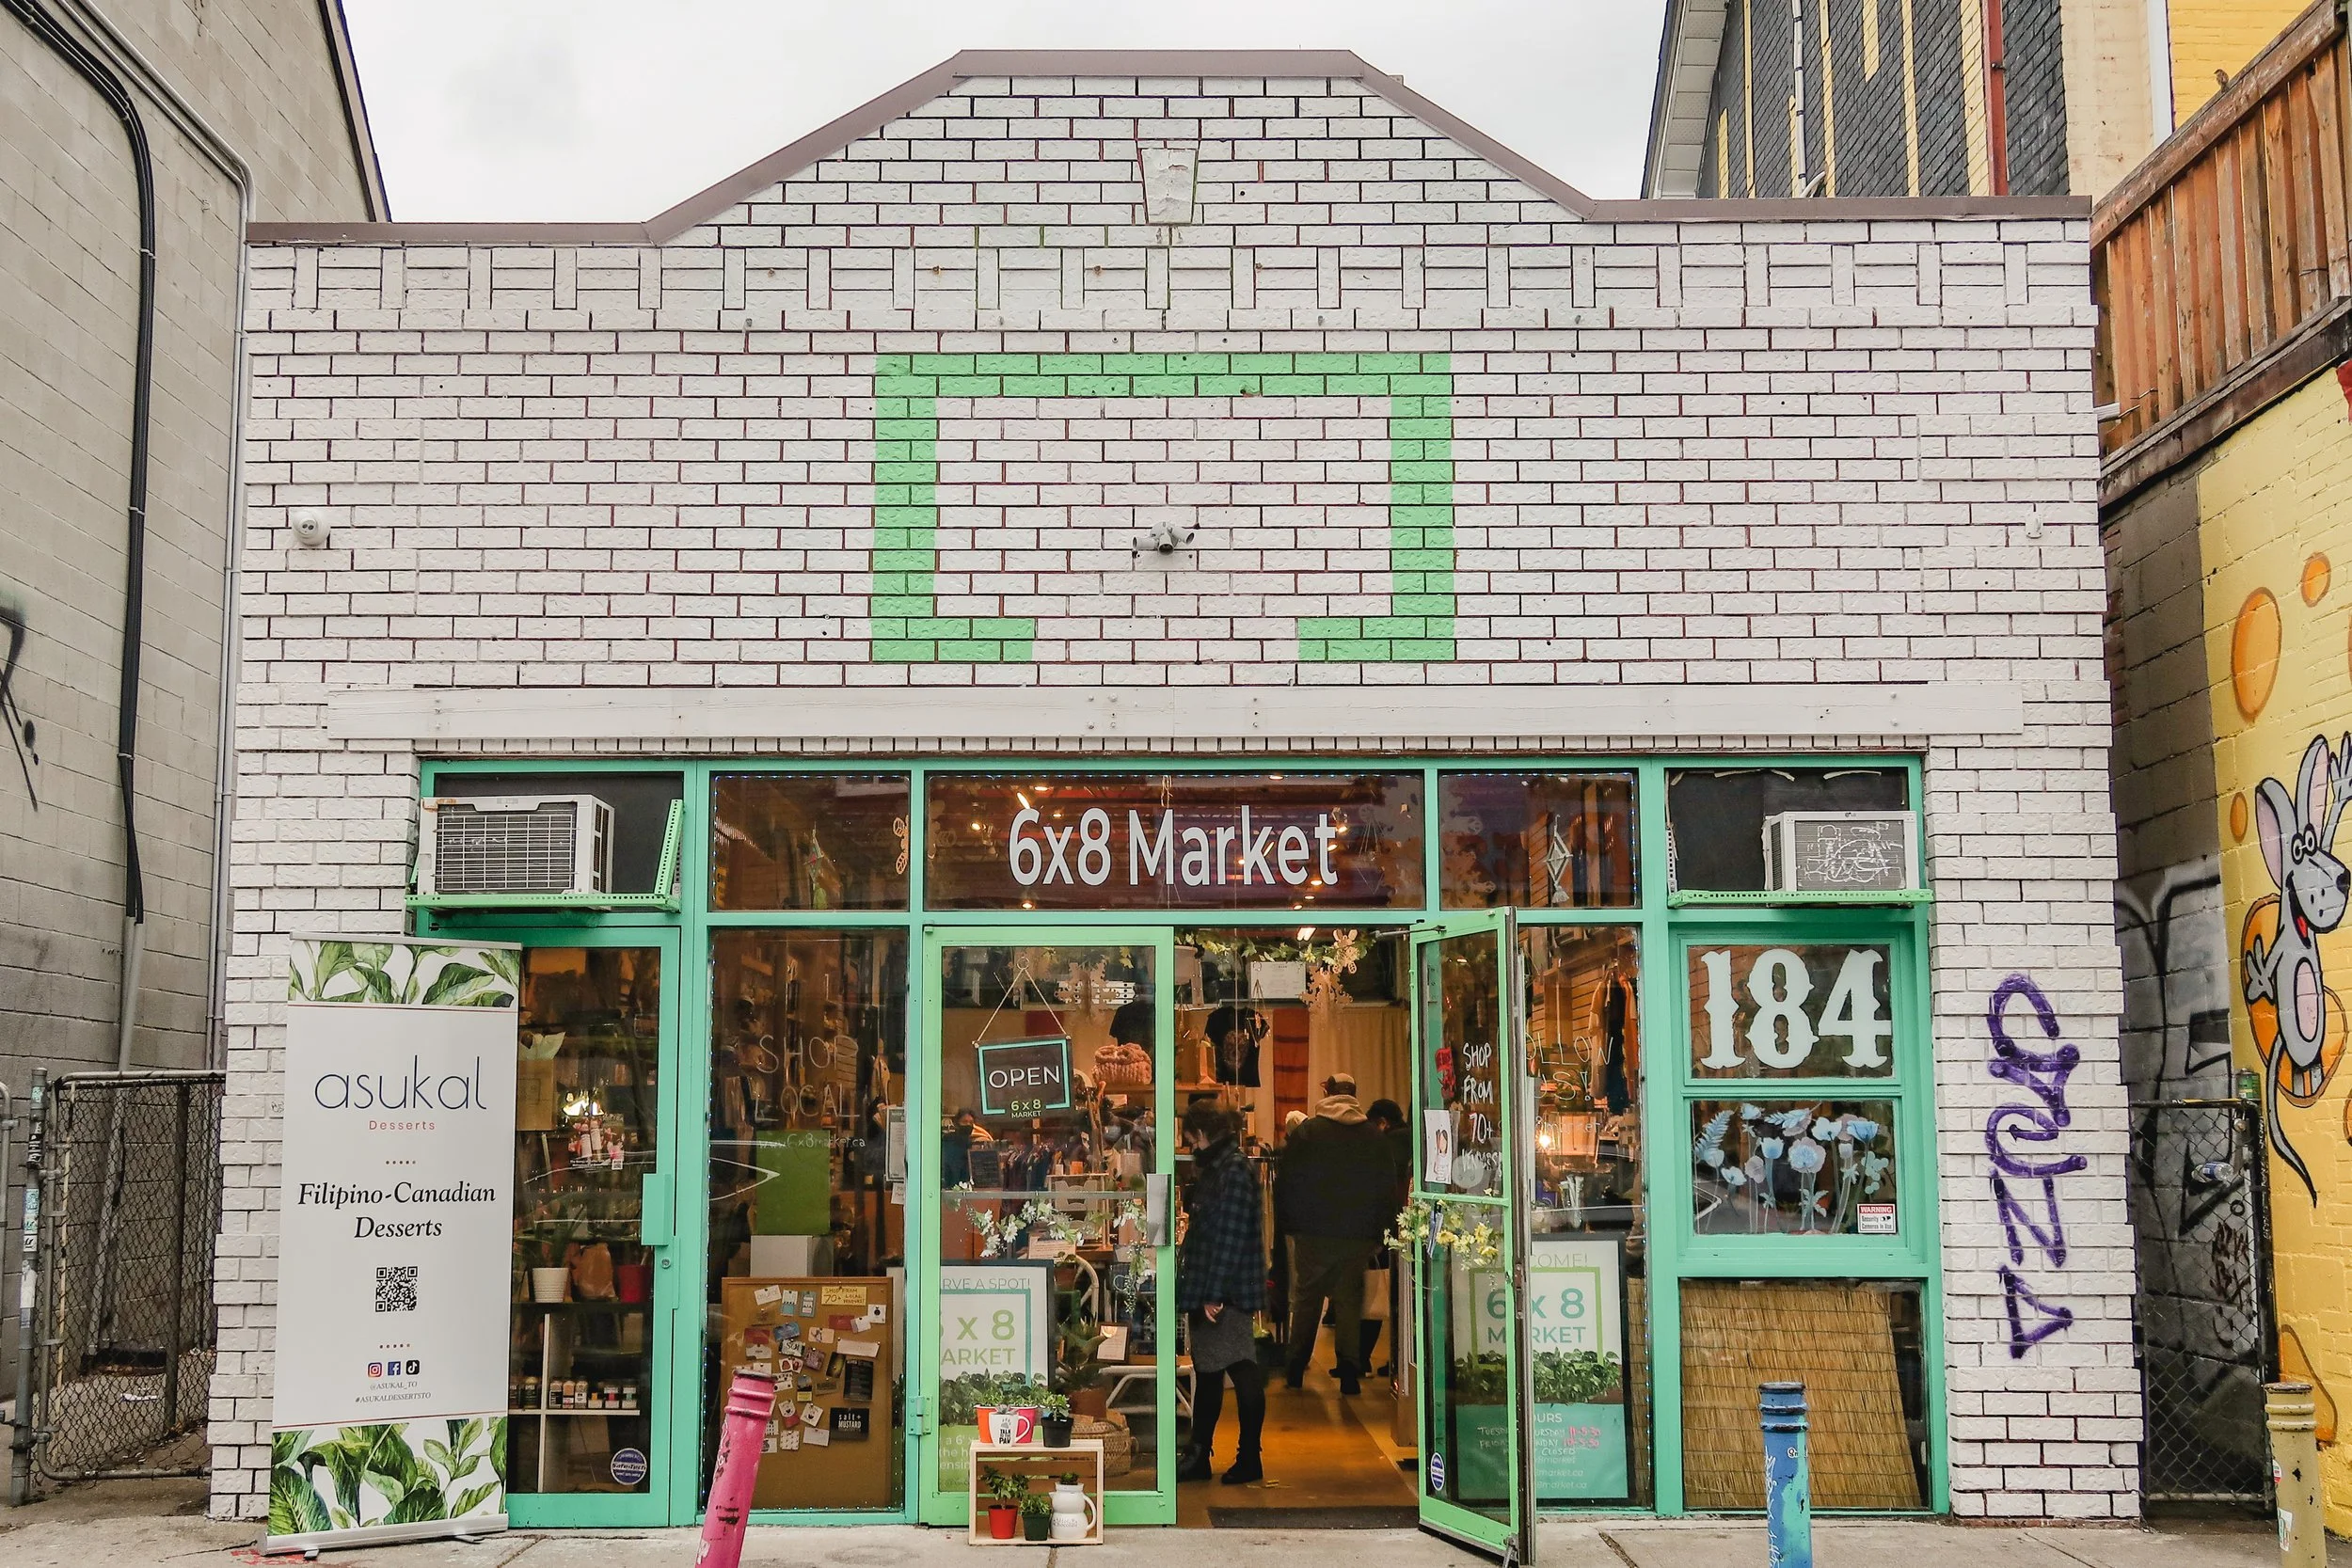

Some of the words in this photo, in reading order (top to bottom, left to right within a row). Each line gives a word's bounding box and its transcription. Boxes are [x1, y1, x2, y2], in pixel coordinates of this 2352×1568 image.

[1009, 807, 1111, 886] 6x8
[1129, 804, 1338, 886] Market
[1699, 948, 1893, 1069] 184
[756, 1035, 859, 1073] SHOP
[1462, 1042, 1492, 1070] SHOP
[315, 1054, 486, 1110] asukal
[989, 1065, 1060, 1088] OPEN
[1463, 1074, 1494, 1104] FROM
[755, 1084, 860, 1122] LOCAL
[1010, 1101, 1019, 1111] 6
[1033, 1099, 1041, 1110] 8
[369, 1120, 436, 1131] Desserts
[1469, 1112, 1494, 1144] 70+
[298, 1180, 496, 1210] Filipino-Canadian
[355, 1216, 442, 1238] Desserts
[989, 1278, 1030, 1290] SPOT!
[1561, 1288, 1585, 1319] 8
[992, 1309, 1015, 1340] 8
[1487, 1326, 1586, 1343] MRKET
[941, 1348, 1016, 1365] ARKET
[356, 1392, 432, 1402] #ASUKALDESSERTSTO
[370, 1381, 418, 1390] @ASUKAL_TO
[838, 1420, 862, 1429] MUSTARD
